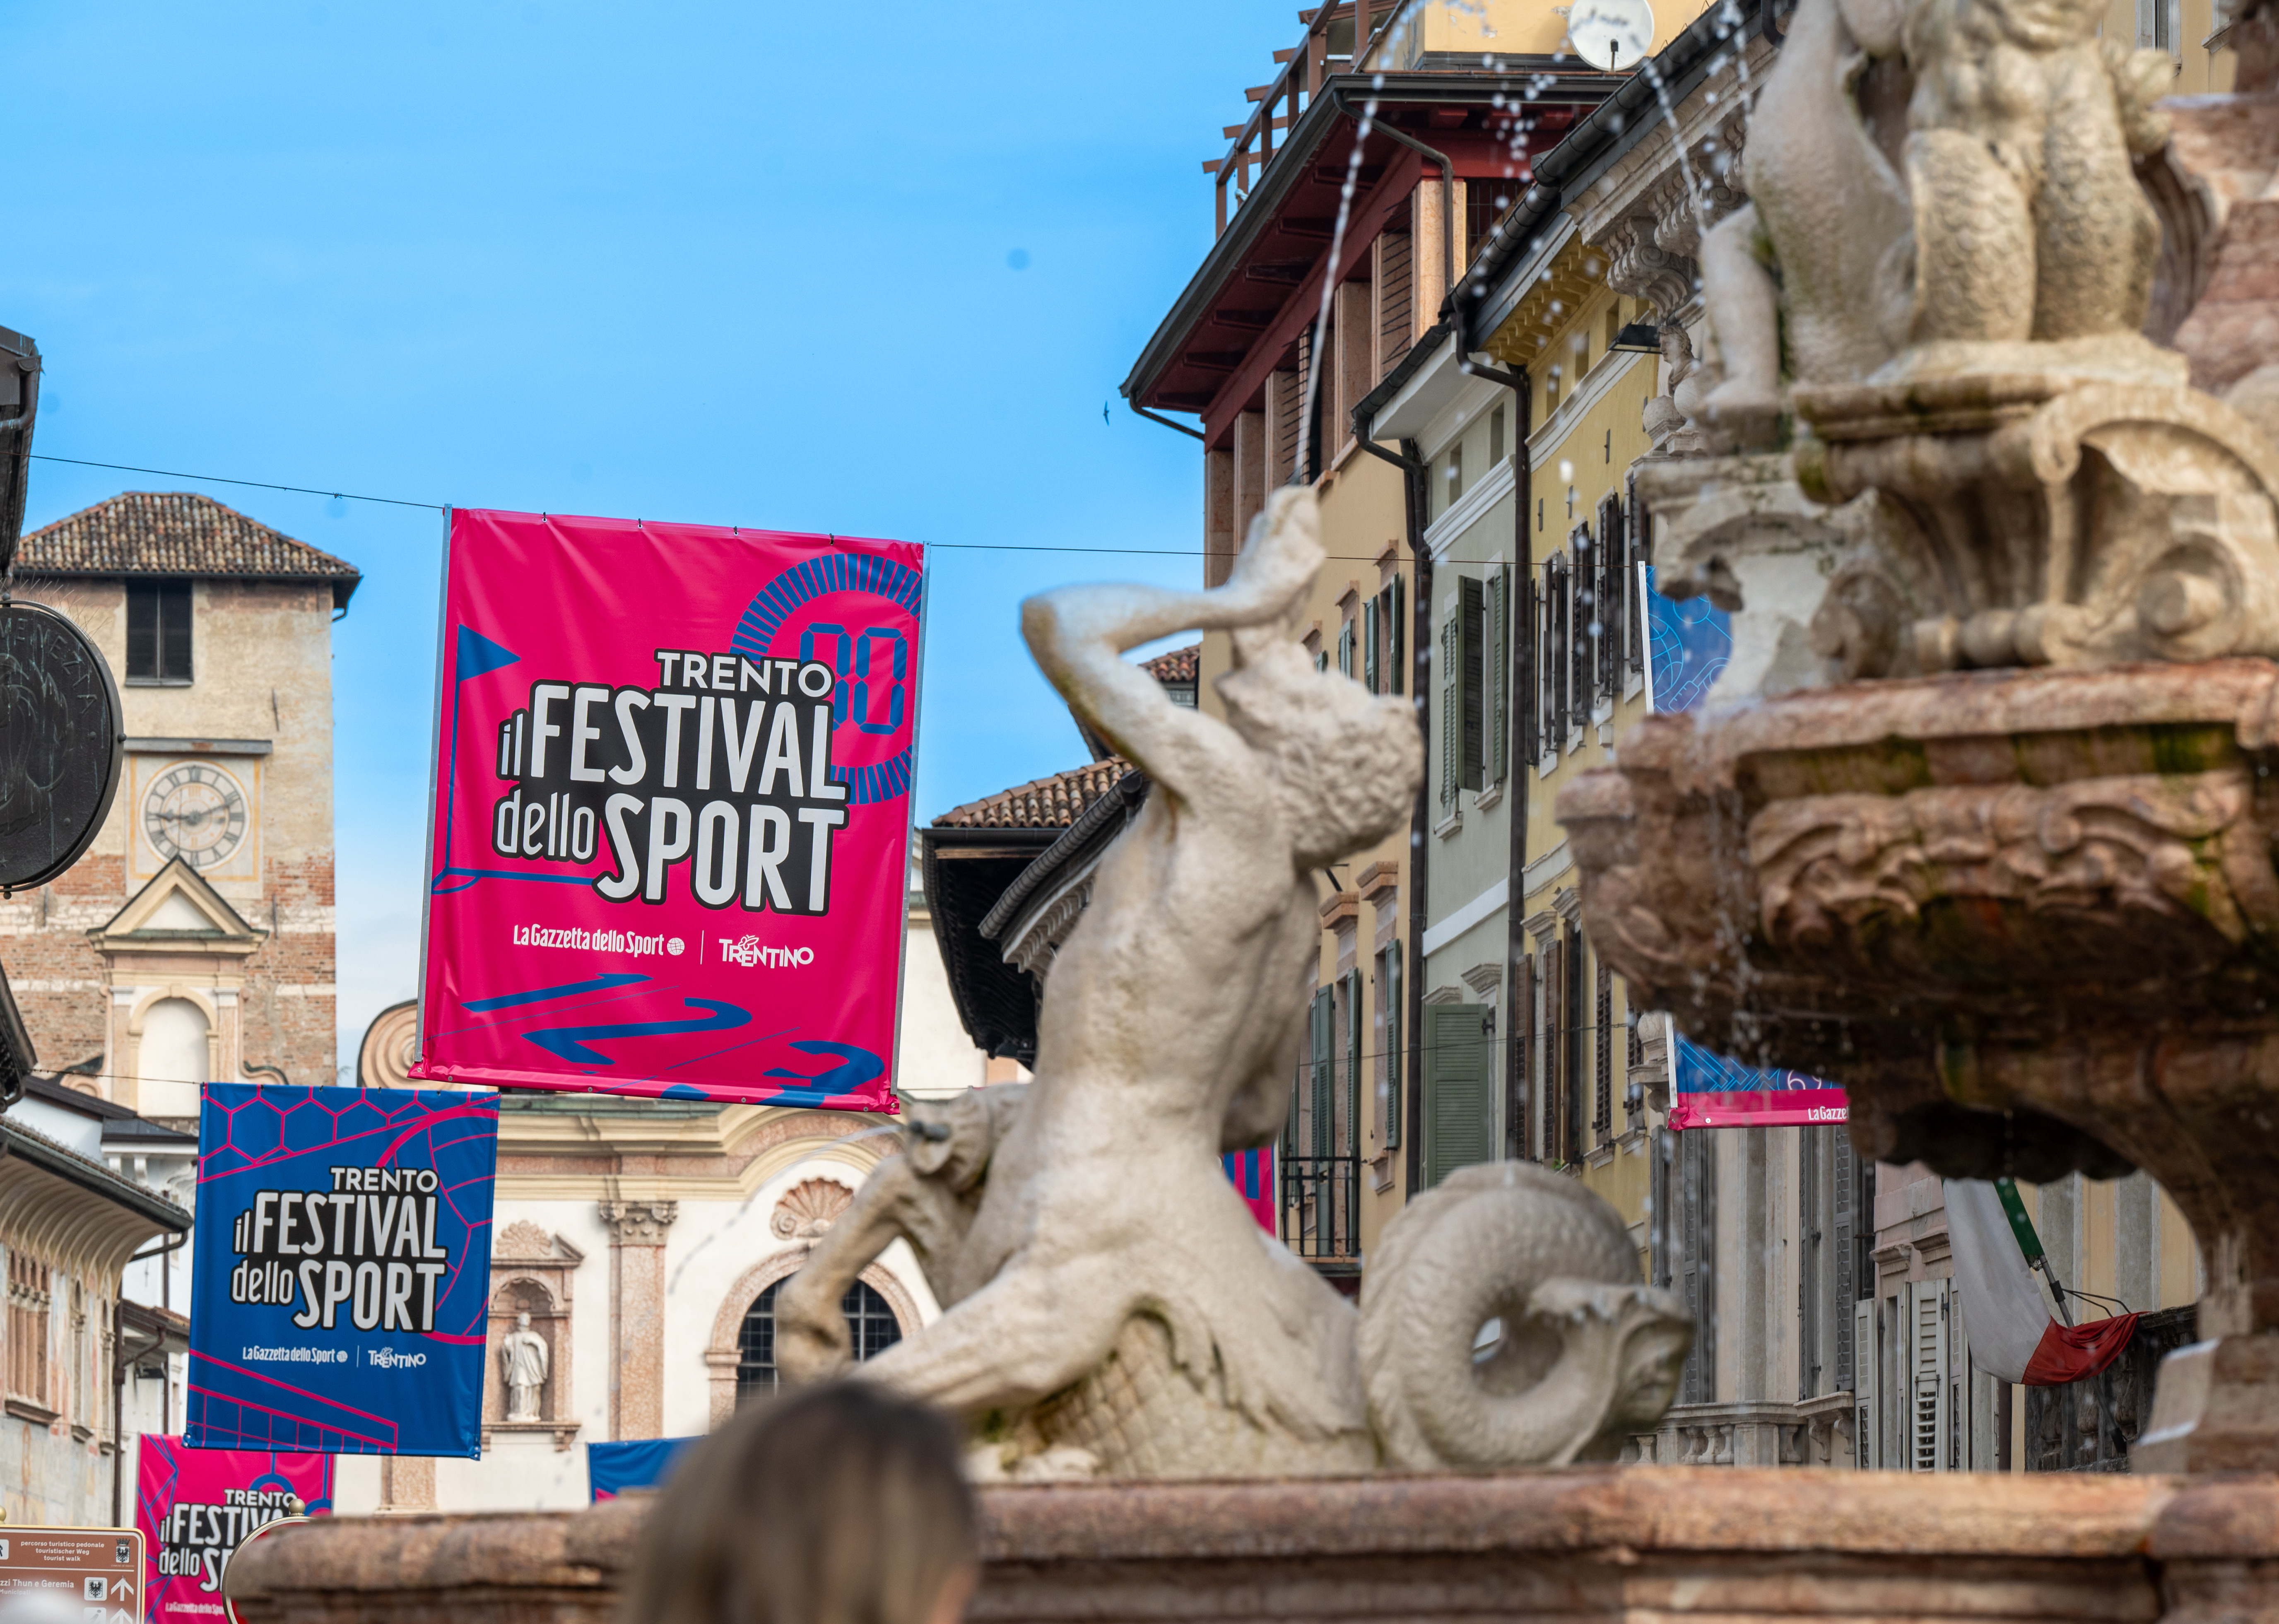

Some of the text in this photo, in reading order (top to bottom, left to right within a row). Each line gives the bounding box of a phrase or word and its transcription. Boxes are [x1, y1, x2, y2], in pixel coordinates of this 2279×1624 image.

[656, 651, 832, 698] TRENTO
[501, 685, 846, 799] il FESTIVAL
[498, 790, 845, 911] dello SPORT
[513, 923, 664, 957] La Gazzetta dello Sport
[719, 938, 814, 969] TRENTINO
[1808, 1108, 1819, 1120] La
[330, 1167, 438, 1192] TRENTO
[236, 1192, 446, 1258] il FESTIVAL
[233, 1259, 445, 1330] dello SPORT
[243, 1345, 335, 1365] La Gazzetta dello Sport
[368, 1350, 426, 1369] TRENTINO
[224, 1489, 298, 1508] TRENTO
[160, 1503, 284, 1546] il FESTIV
[159, 1547, 200, 1576] dello
[12, 1579, 32, 1587] Thun
[41, 1580, 74, 1588] Geremia
